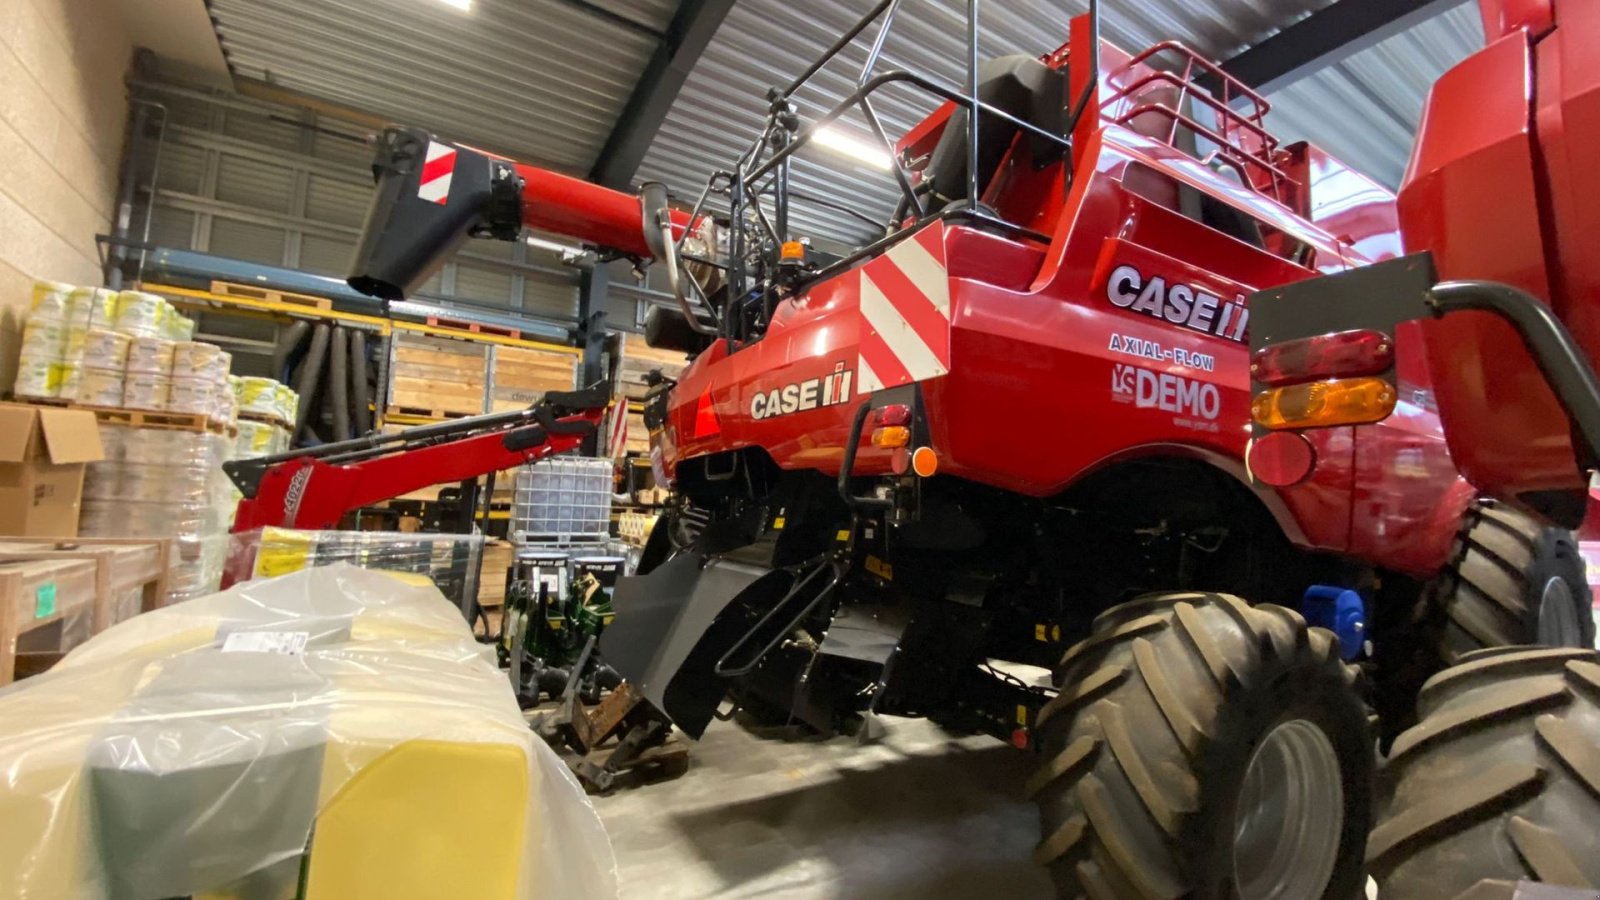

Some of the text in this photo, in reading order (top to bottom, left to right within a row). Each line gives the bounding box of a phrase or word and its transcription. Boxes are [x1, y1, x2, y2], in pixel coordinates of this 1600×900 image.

[1107, 265, 1219, 332] CASE
[1109, 333, 1214, 372] AXIAL-FLOW
[751, 378, 819, 420] CASE
[1136, 367, 1220, 420] DEMO
